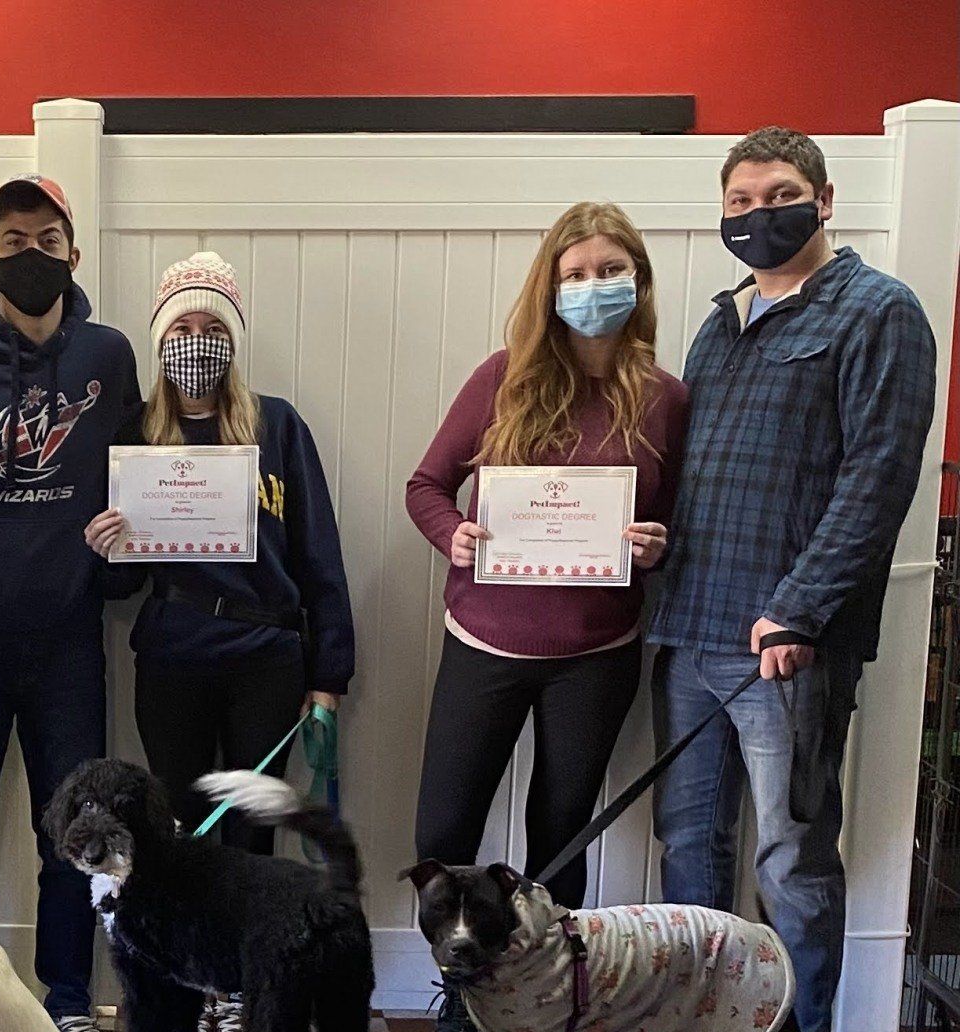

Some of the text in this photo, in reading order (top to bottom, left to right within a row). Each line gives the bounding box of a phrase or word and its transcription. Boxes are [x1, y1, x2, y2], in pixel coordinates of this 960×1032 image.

[141, 491, 223, 499] DOGTASTIC DEGREE
[511, 512, 597, 521] DOGTASTIC DEGREE
